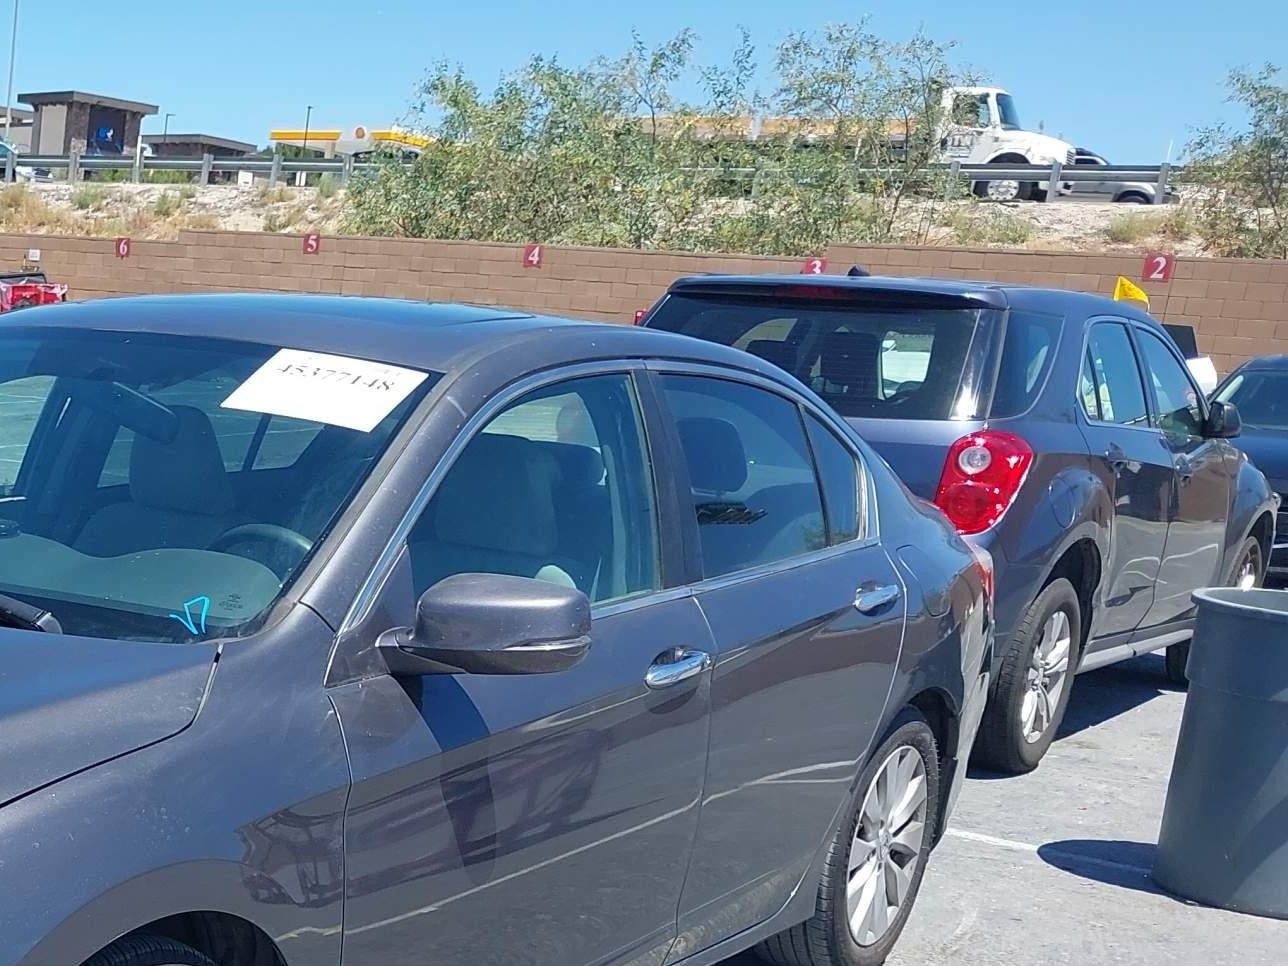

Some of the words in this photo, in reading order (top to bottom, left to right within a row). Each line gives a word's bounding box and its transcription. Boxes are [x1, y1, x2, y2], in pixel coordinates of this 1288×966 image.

[119, 239, 127, 255] 6
[307, 236, 317, 252] 5
[528, 246, 540, 264] 4
[810, 260, 822, 274] 3
[1150, 256, 1167, 279] 2
[275, 363, 396, 392] 45377148
